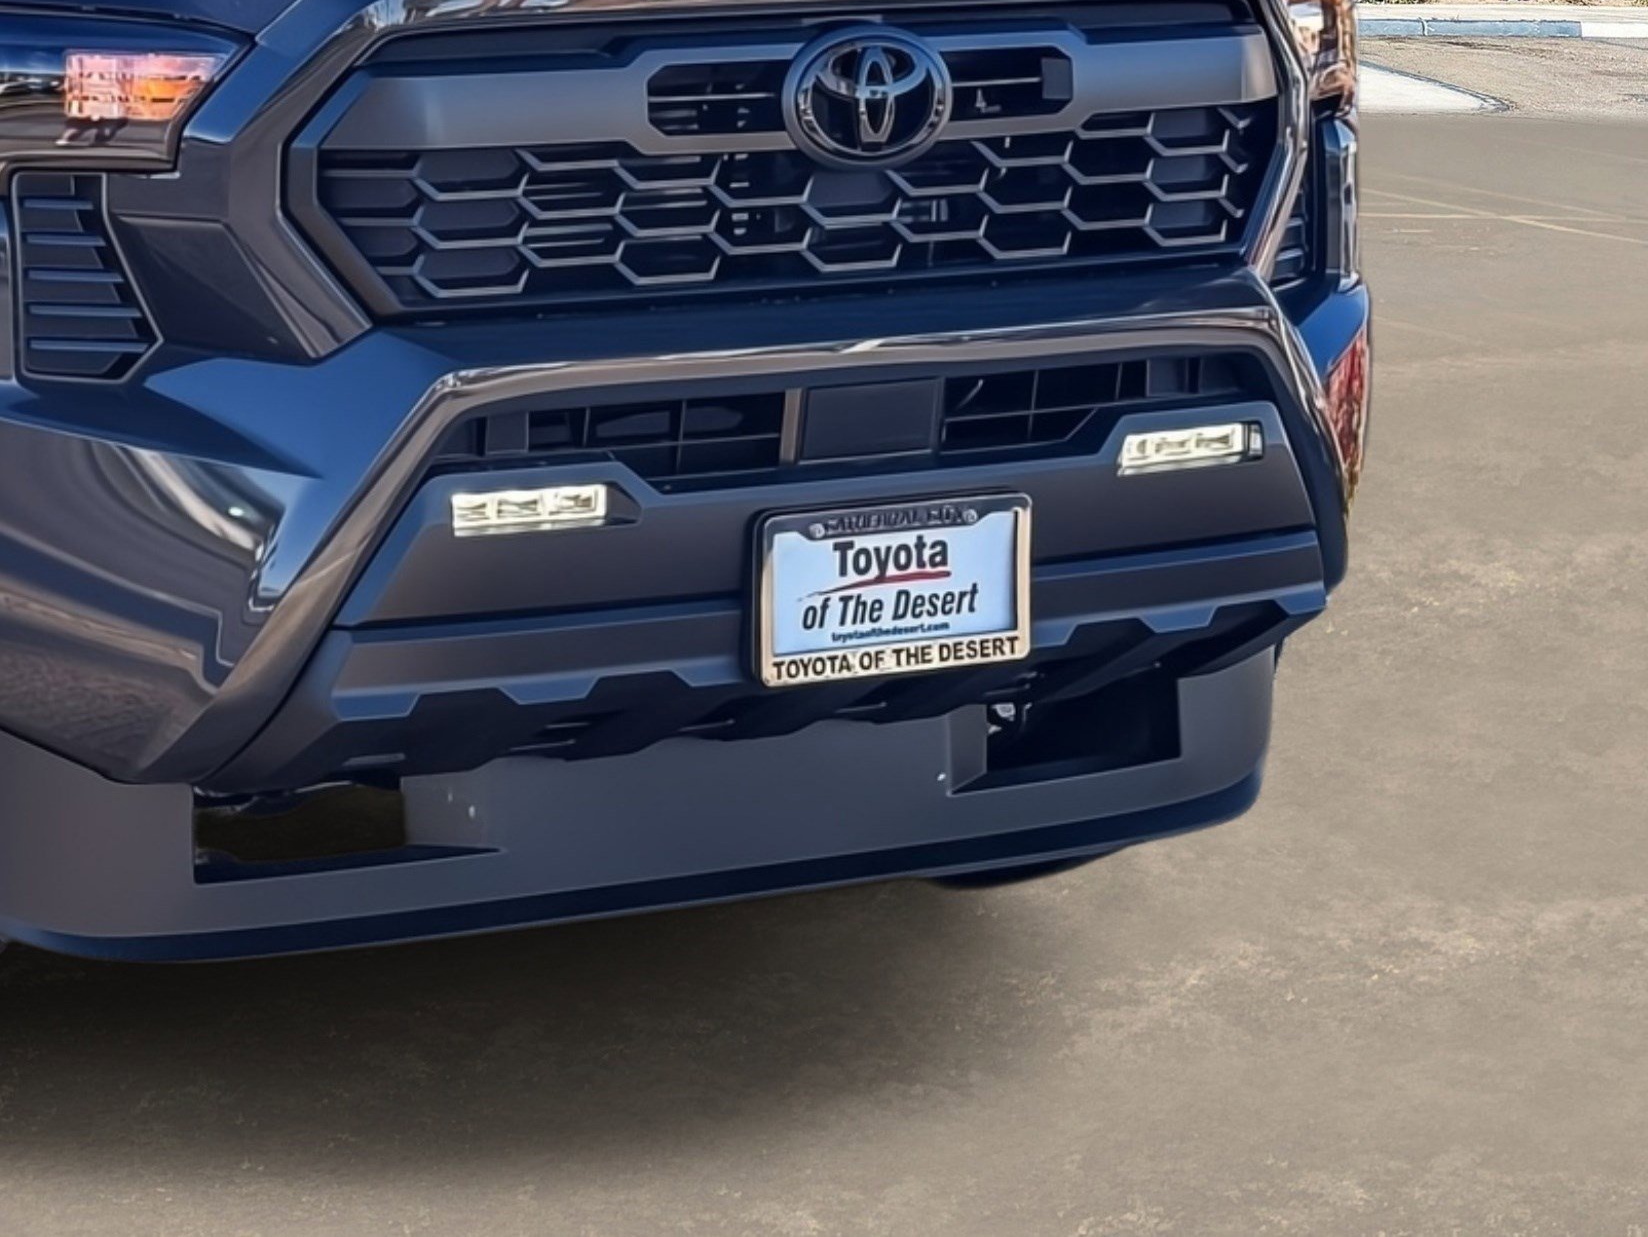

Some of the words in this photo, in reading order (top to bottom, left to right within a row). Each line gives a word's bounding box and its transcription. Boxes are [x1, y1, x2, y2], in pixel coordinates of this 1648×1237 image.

[833, 535, 948, 580] Toyota
[802, 597, 831, 630] of
[838, 593, 883, 626] The
[892, 583, 979, 621] Desert
[773, 655, 852, 680] TOYOTA
[859, 651, 888, 671] OF
[892, 645, 933, 667] THE
[939, 637, 1019, 662] DESERT
